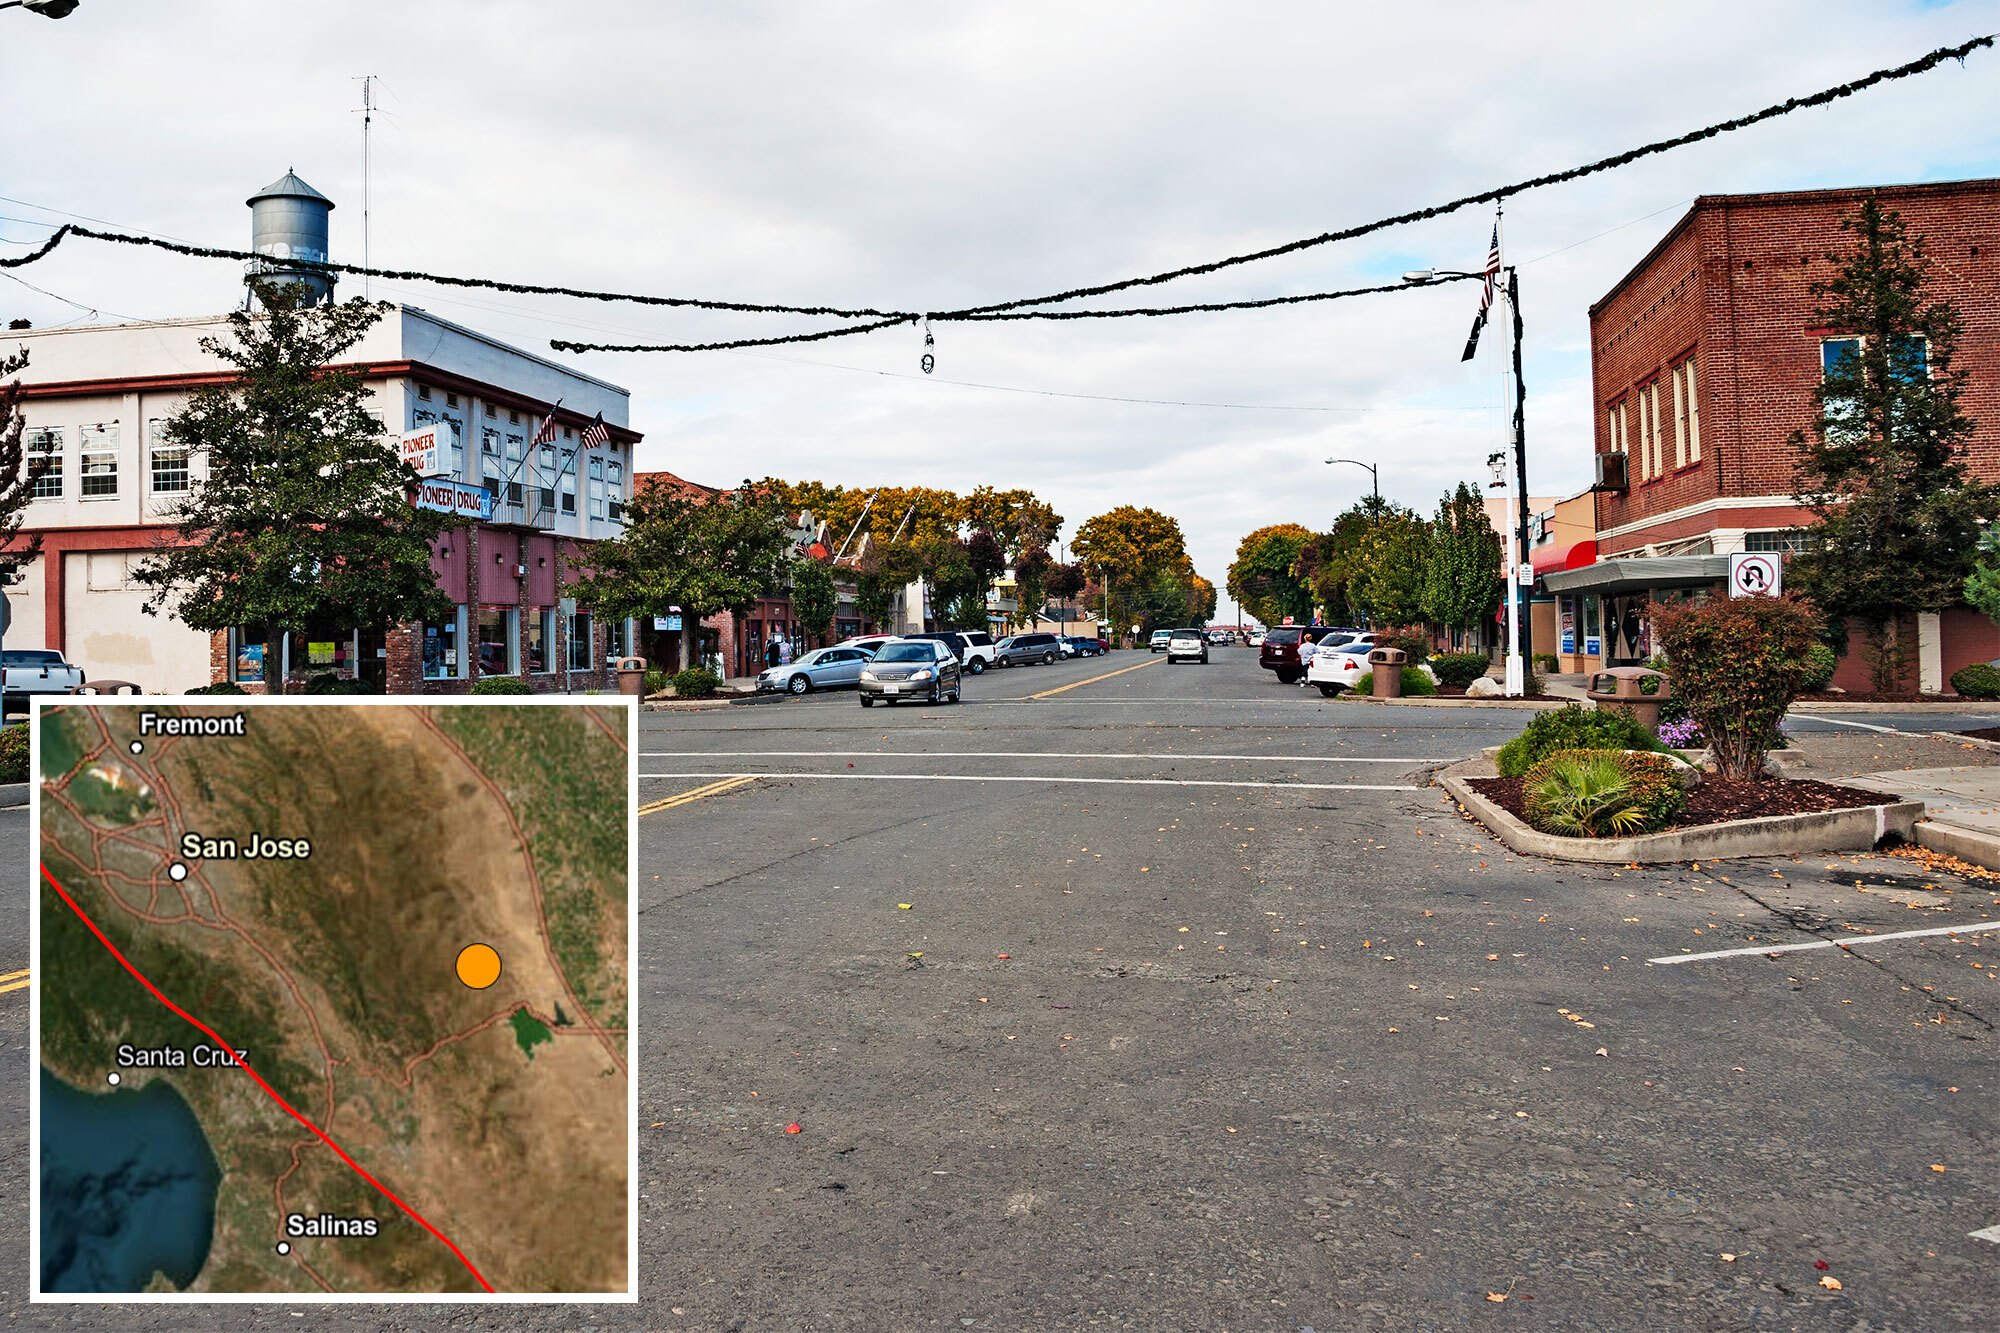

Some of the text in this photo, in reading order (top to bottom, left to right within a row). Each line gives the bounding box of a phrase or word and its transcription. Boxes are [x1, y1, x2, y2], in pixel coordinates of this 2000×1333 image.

[403, 433, 435, 454] PIONEER
[416, 484, 481, 512] PIONEER DRUG
